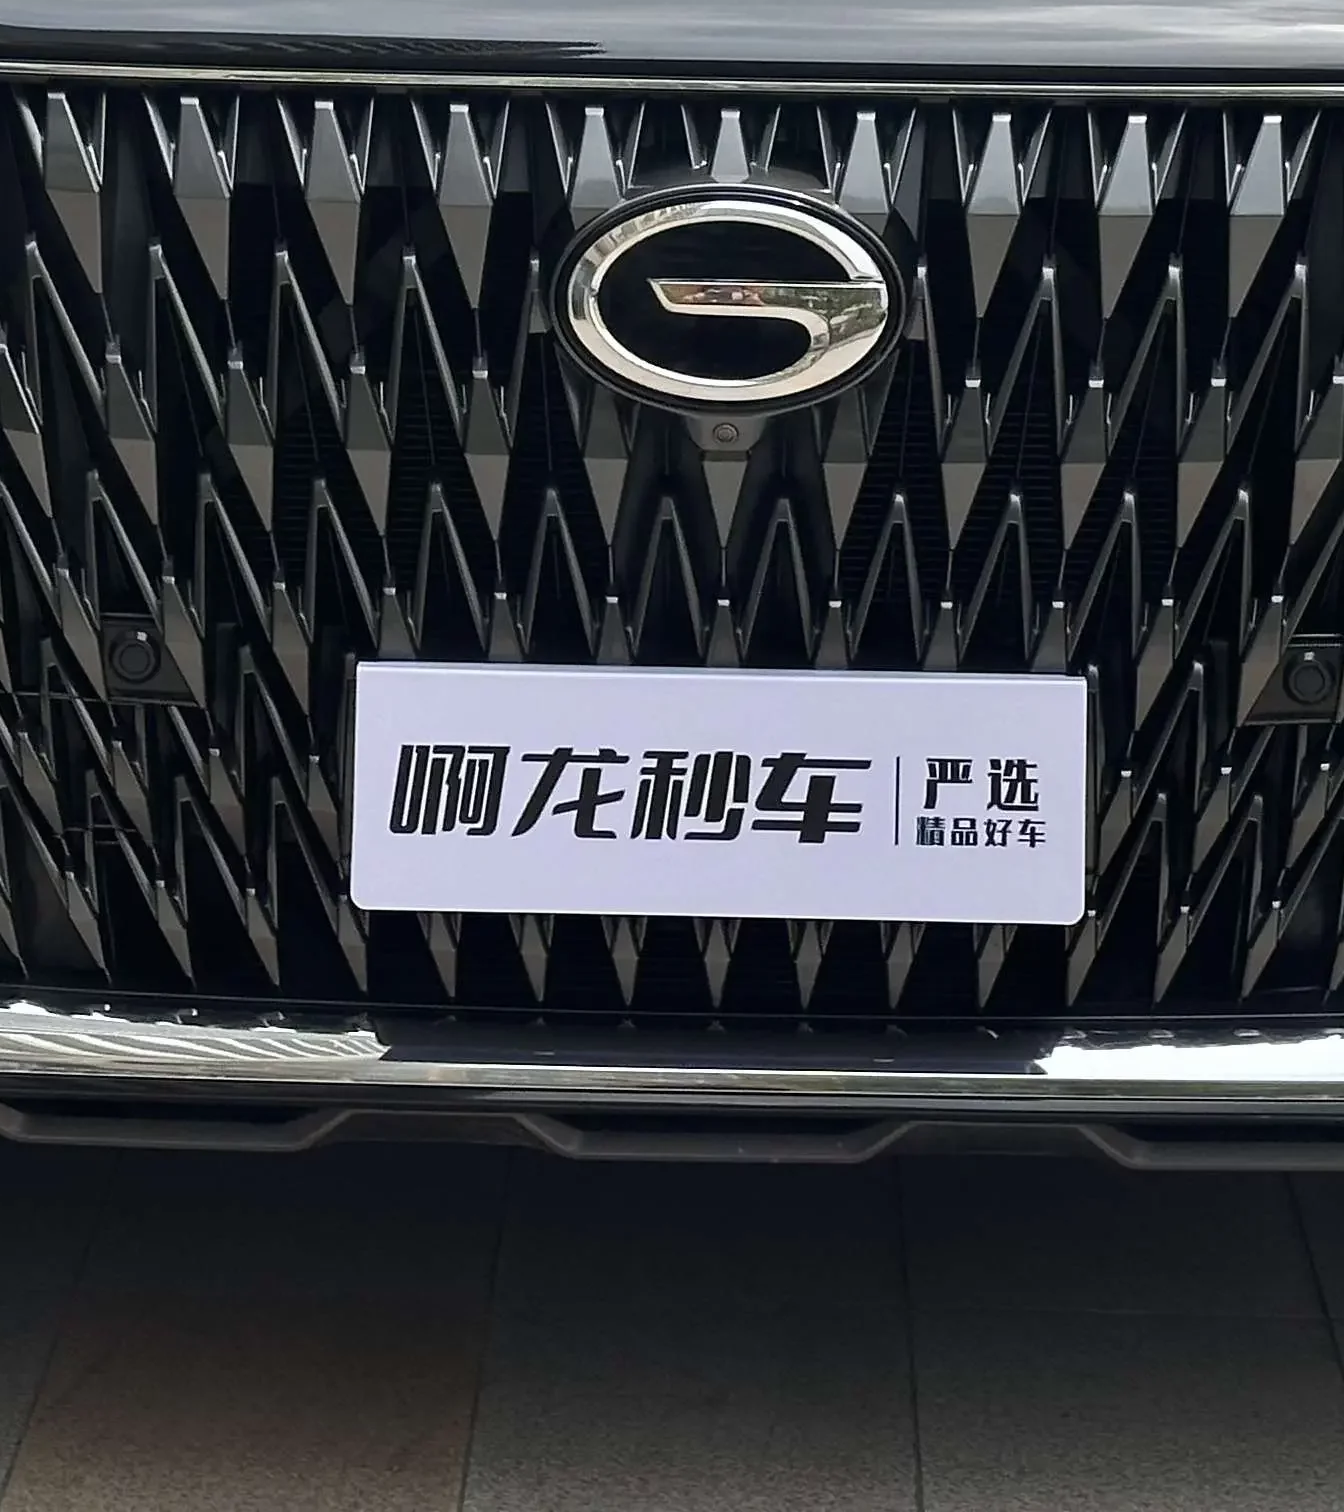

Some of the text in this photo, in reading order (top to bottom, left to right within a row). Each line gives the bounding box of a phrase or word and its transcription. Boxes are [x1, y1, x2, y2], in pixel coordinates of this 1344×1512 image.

[388, 744, 872, 843] 啊龙秒车
[924, 758, 1040, 812] 严选
[916, 816, 1047, 848] 精品好车
